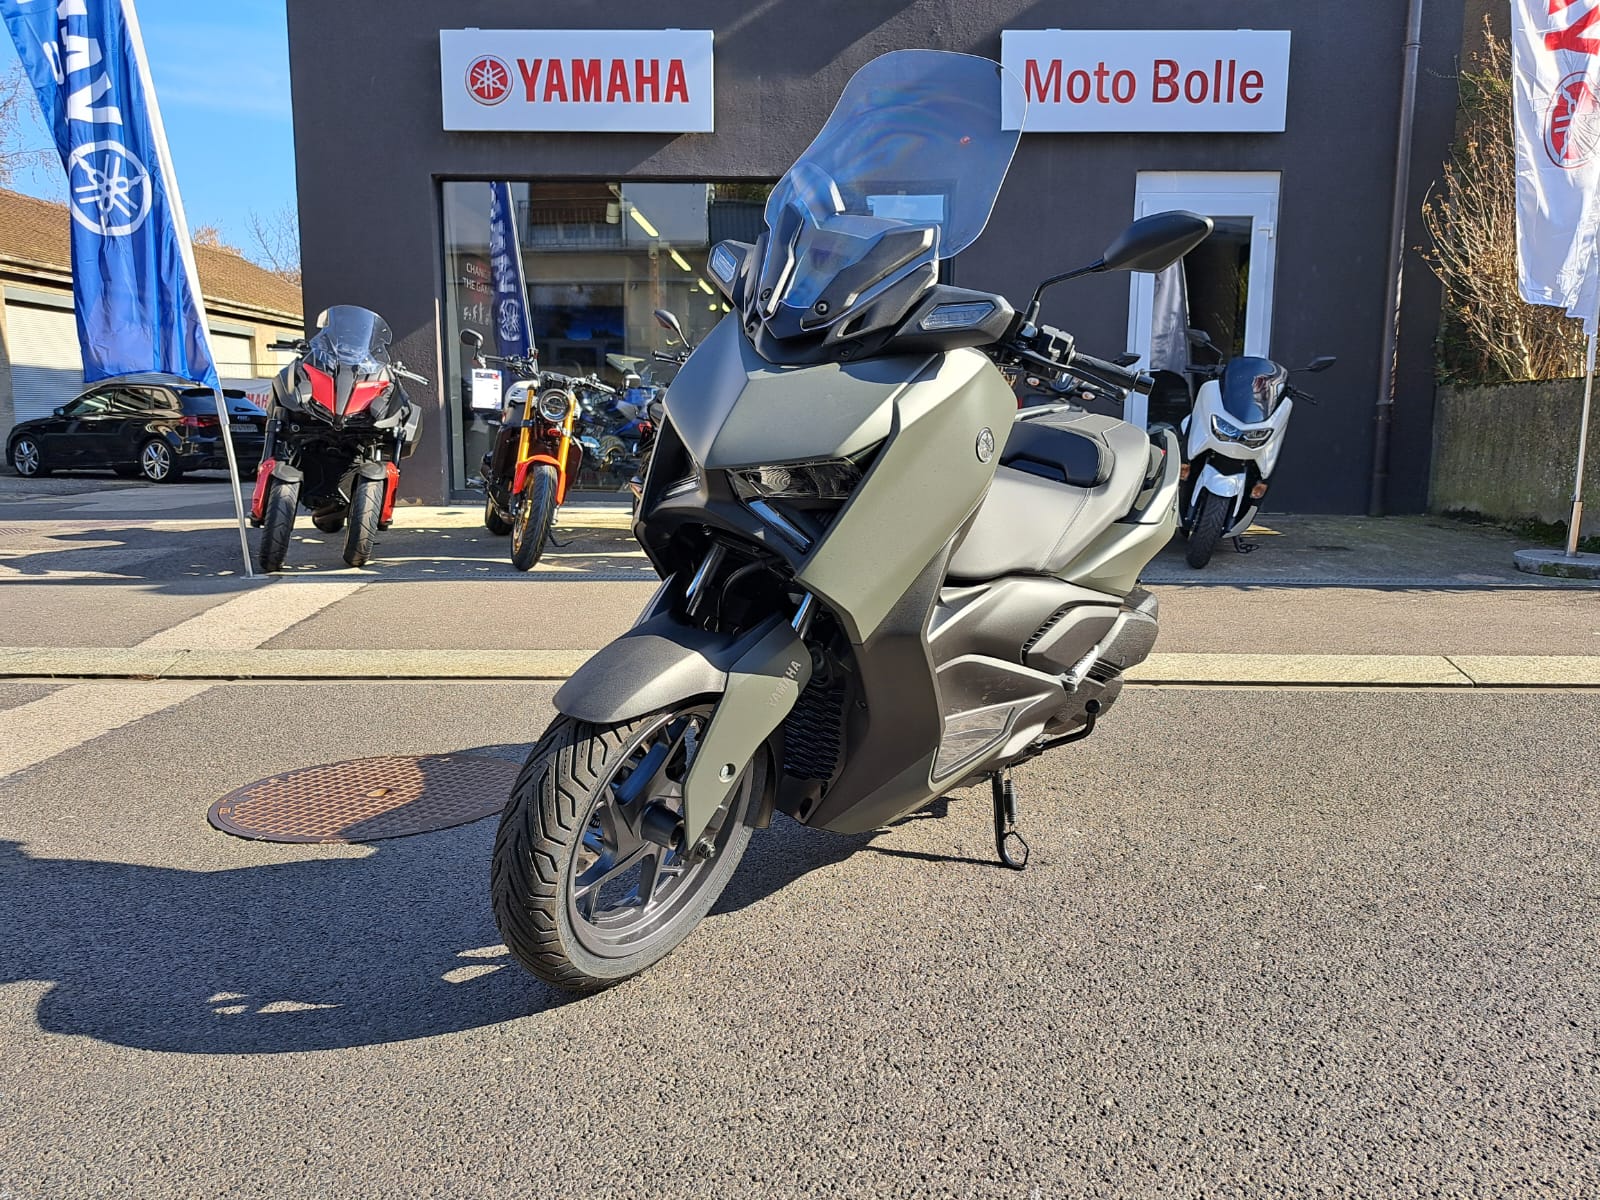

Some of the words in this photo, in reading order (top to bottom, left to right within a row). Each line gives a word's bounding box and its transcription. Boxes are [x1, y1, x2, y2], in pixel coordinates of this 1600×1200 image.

[516, 58, 690, 103] YAMAHA
[1024, 58, 1137, 104] Moto
[1151, 58, 1265, 104] Bolle
[769, 661, 802, 706] YAMAHA
